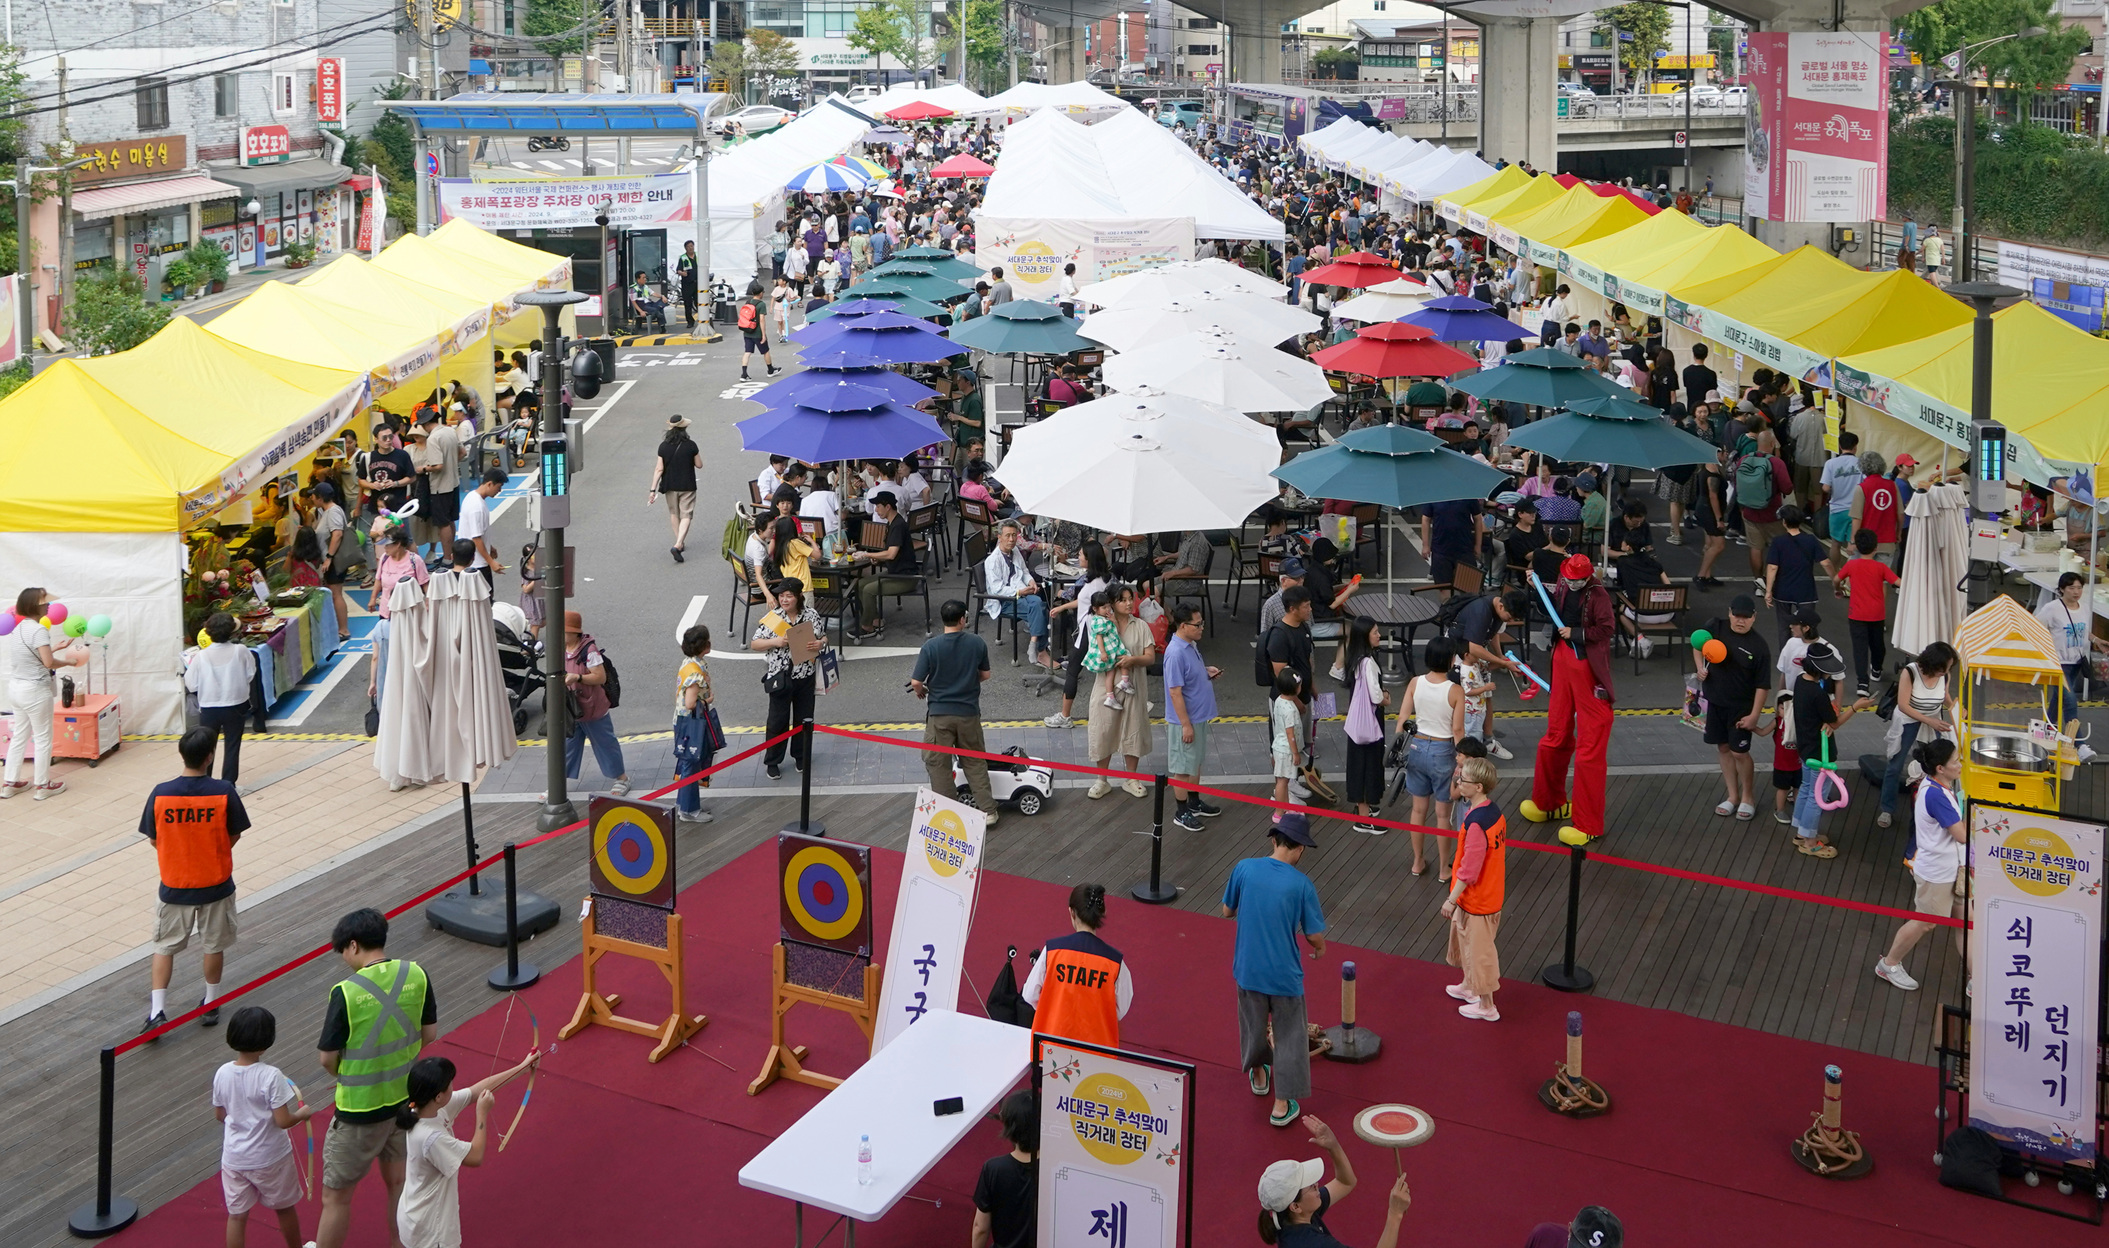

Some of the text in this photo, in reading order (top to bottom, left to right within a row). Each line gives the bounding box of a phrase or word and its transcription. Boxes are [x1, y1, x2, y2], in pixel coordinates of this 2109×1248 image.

[1801, 61, 1869, 71] 글로벌 서울 명소
[1802, 72, 1868, 82] 서대문 홍제폭포
[322, 61, 335, 118] 호호포차
[1793, 114, 1873, 143] 서대문 홍제폭포
[129, 142, 168, 168] 미용실
[248, 133, 288, 155] 호호포차
[460, 194, 539, 209] 홍제폭포광장
[543, 193, 583, 207] 주차장
[618, 191, 643, 204] 제한
[647, 188, 673, 202] 안내
[1007, 255, 1063, 264] 서대문구 추석맞이
[1016, 265, 1053, 274] 직거래 장터
[1724, 325, 1781, 362] 서대문구 스마일 김밥
[1919, 404, 1954, 433] 서대문구
[288, 423, 313, 456] 삼색송편
[313, 411, 331, 438] 만들기
[164, 807, 215, 824] STAFF
[918, 824, 975, 857] 서대문구 추석맞이
[926, 842, 963, 869] 직거래 장터
[1988, 845, 2090, 874] 서대문구 추석맞이
[2006, 863, 2071, 886] 직거래 장터
[1056, 963, 1109, 990] STAFF
[2004, 916, 2034, 1054] 쇠코뚜레
[2042, 1004, 2070, 1107] 던지기
[1101, 1087, 1124, 1099] 2024년
[1056, 1095, 1168, 1136] 서대문구 추석맞이
[1075, 1120, 1147, 1152] 직거래 장터
[1088, 1200, 1128, 1248] 제
[1588, 1230, 1605, 1247] S
